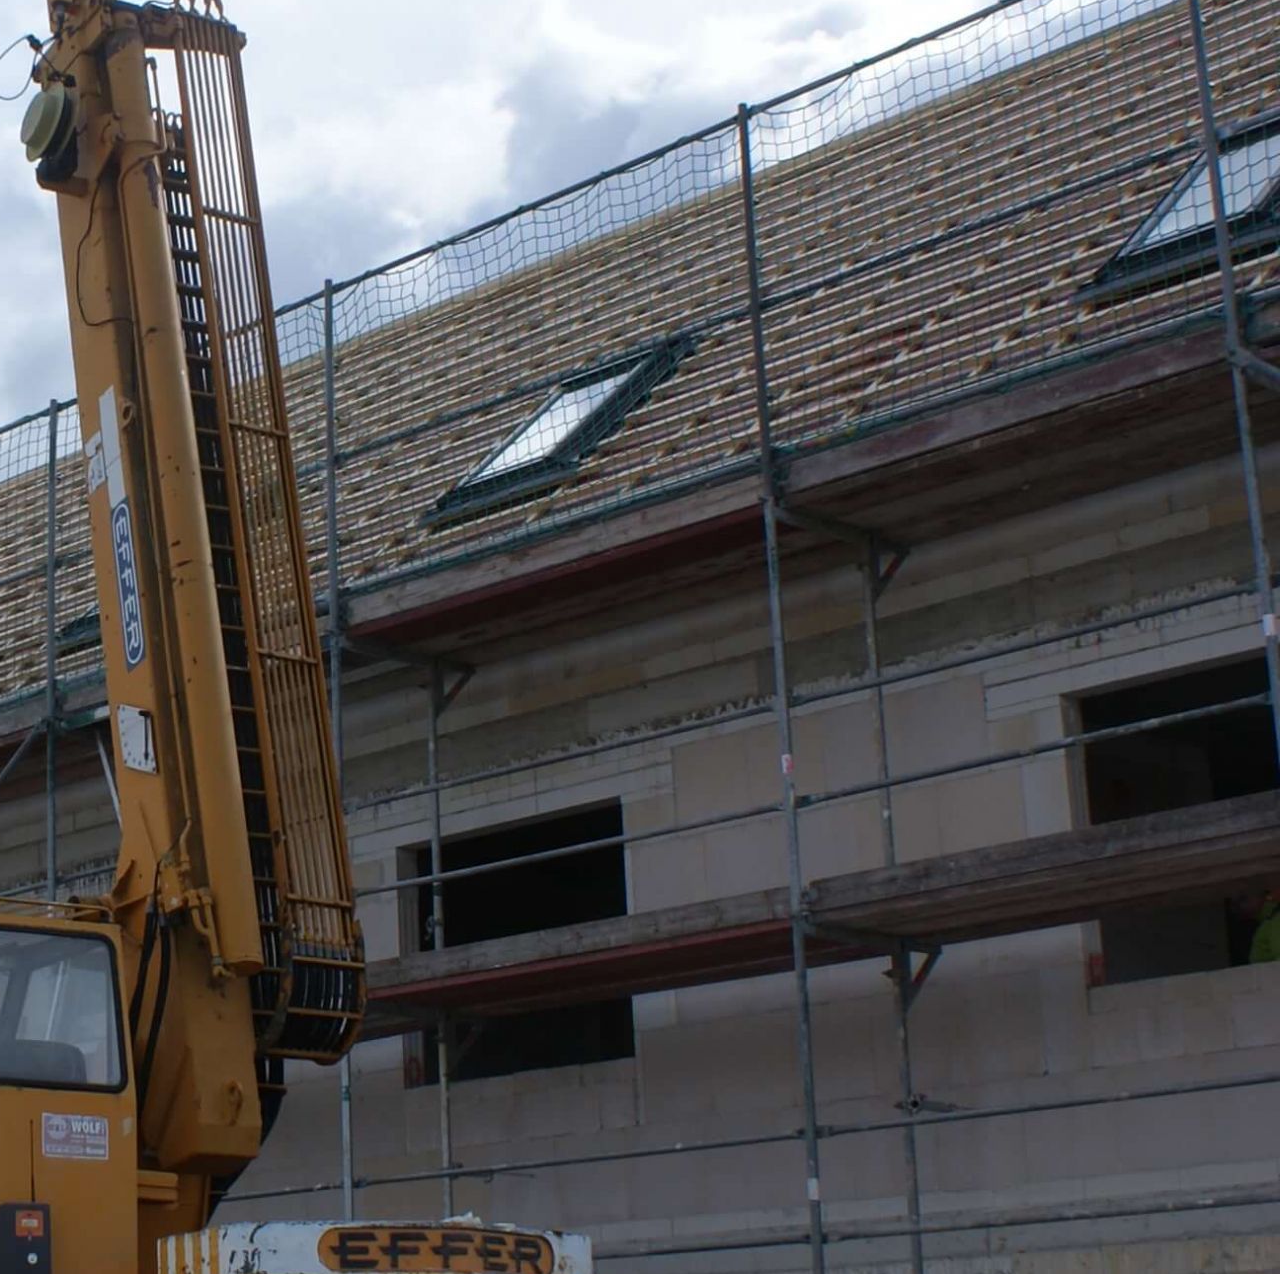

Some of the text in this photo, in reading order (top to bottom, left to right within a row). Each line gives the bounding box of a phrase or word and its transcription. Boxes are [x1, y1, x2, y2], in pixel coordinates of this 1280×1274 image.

[115, 515, 140, 652] EFFER
[71, 1118, 100, 1134] WOLF
[329, 1231, 544, 1274] EFFER
